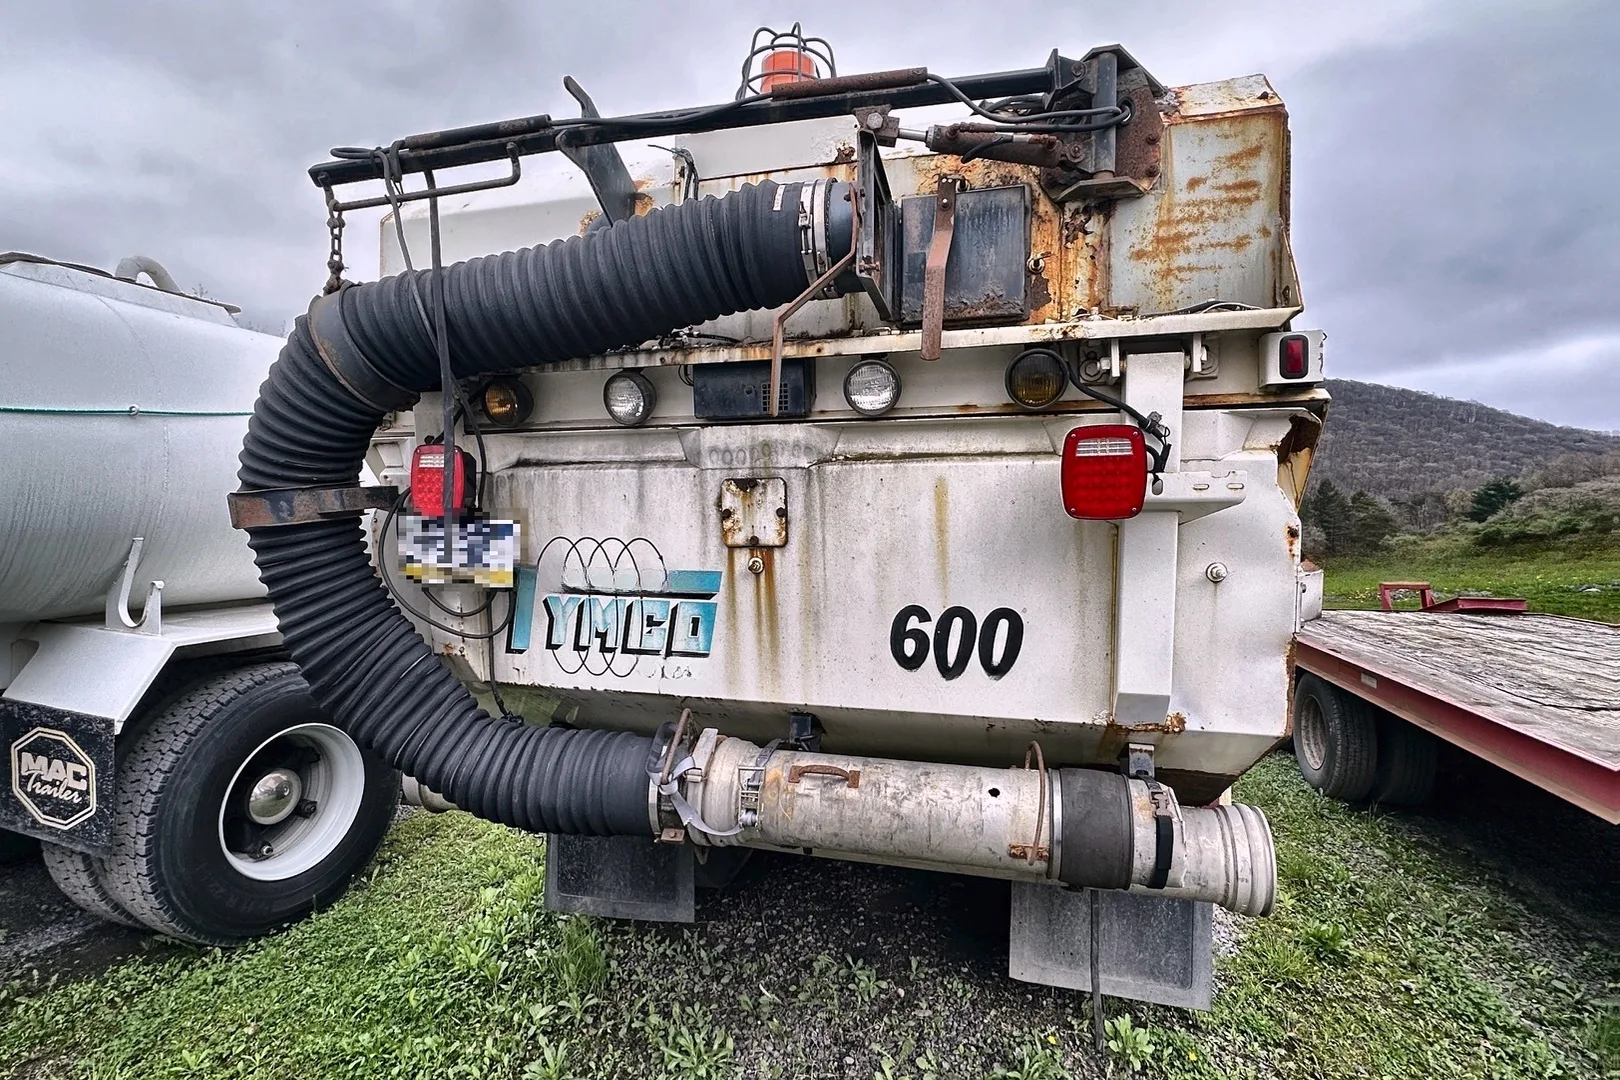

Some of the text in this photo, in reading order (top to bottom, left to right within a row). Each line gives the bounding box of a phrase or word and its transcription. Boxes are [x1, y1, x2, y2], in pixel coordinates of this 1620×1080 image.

[890, 604, 1024, 681] 600
[21, 752, 88, 791] MAC
[23, 769, 82, 804] Trailer
